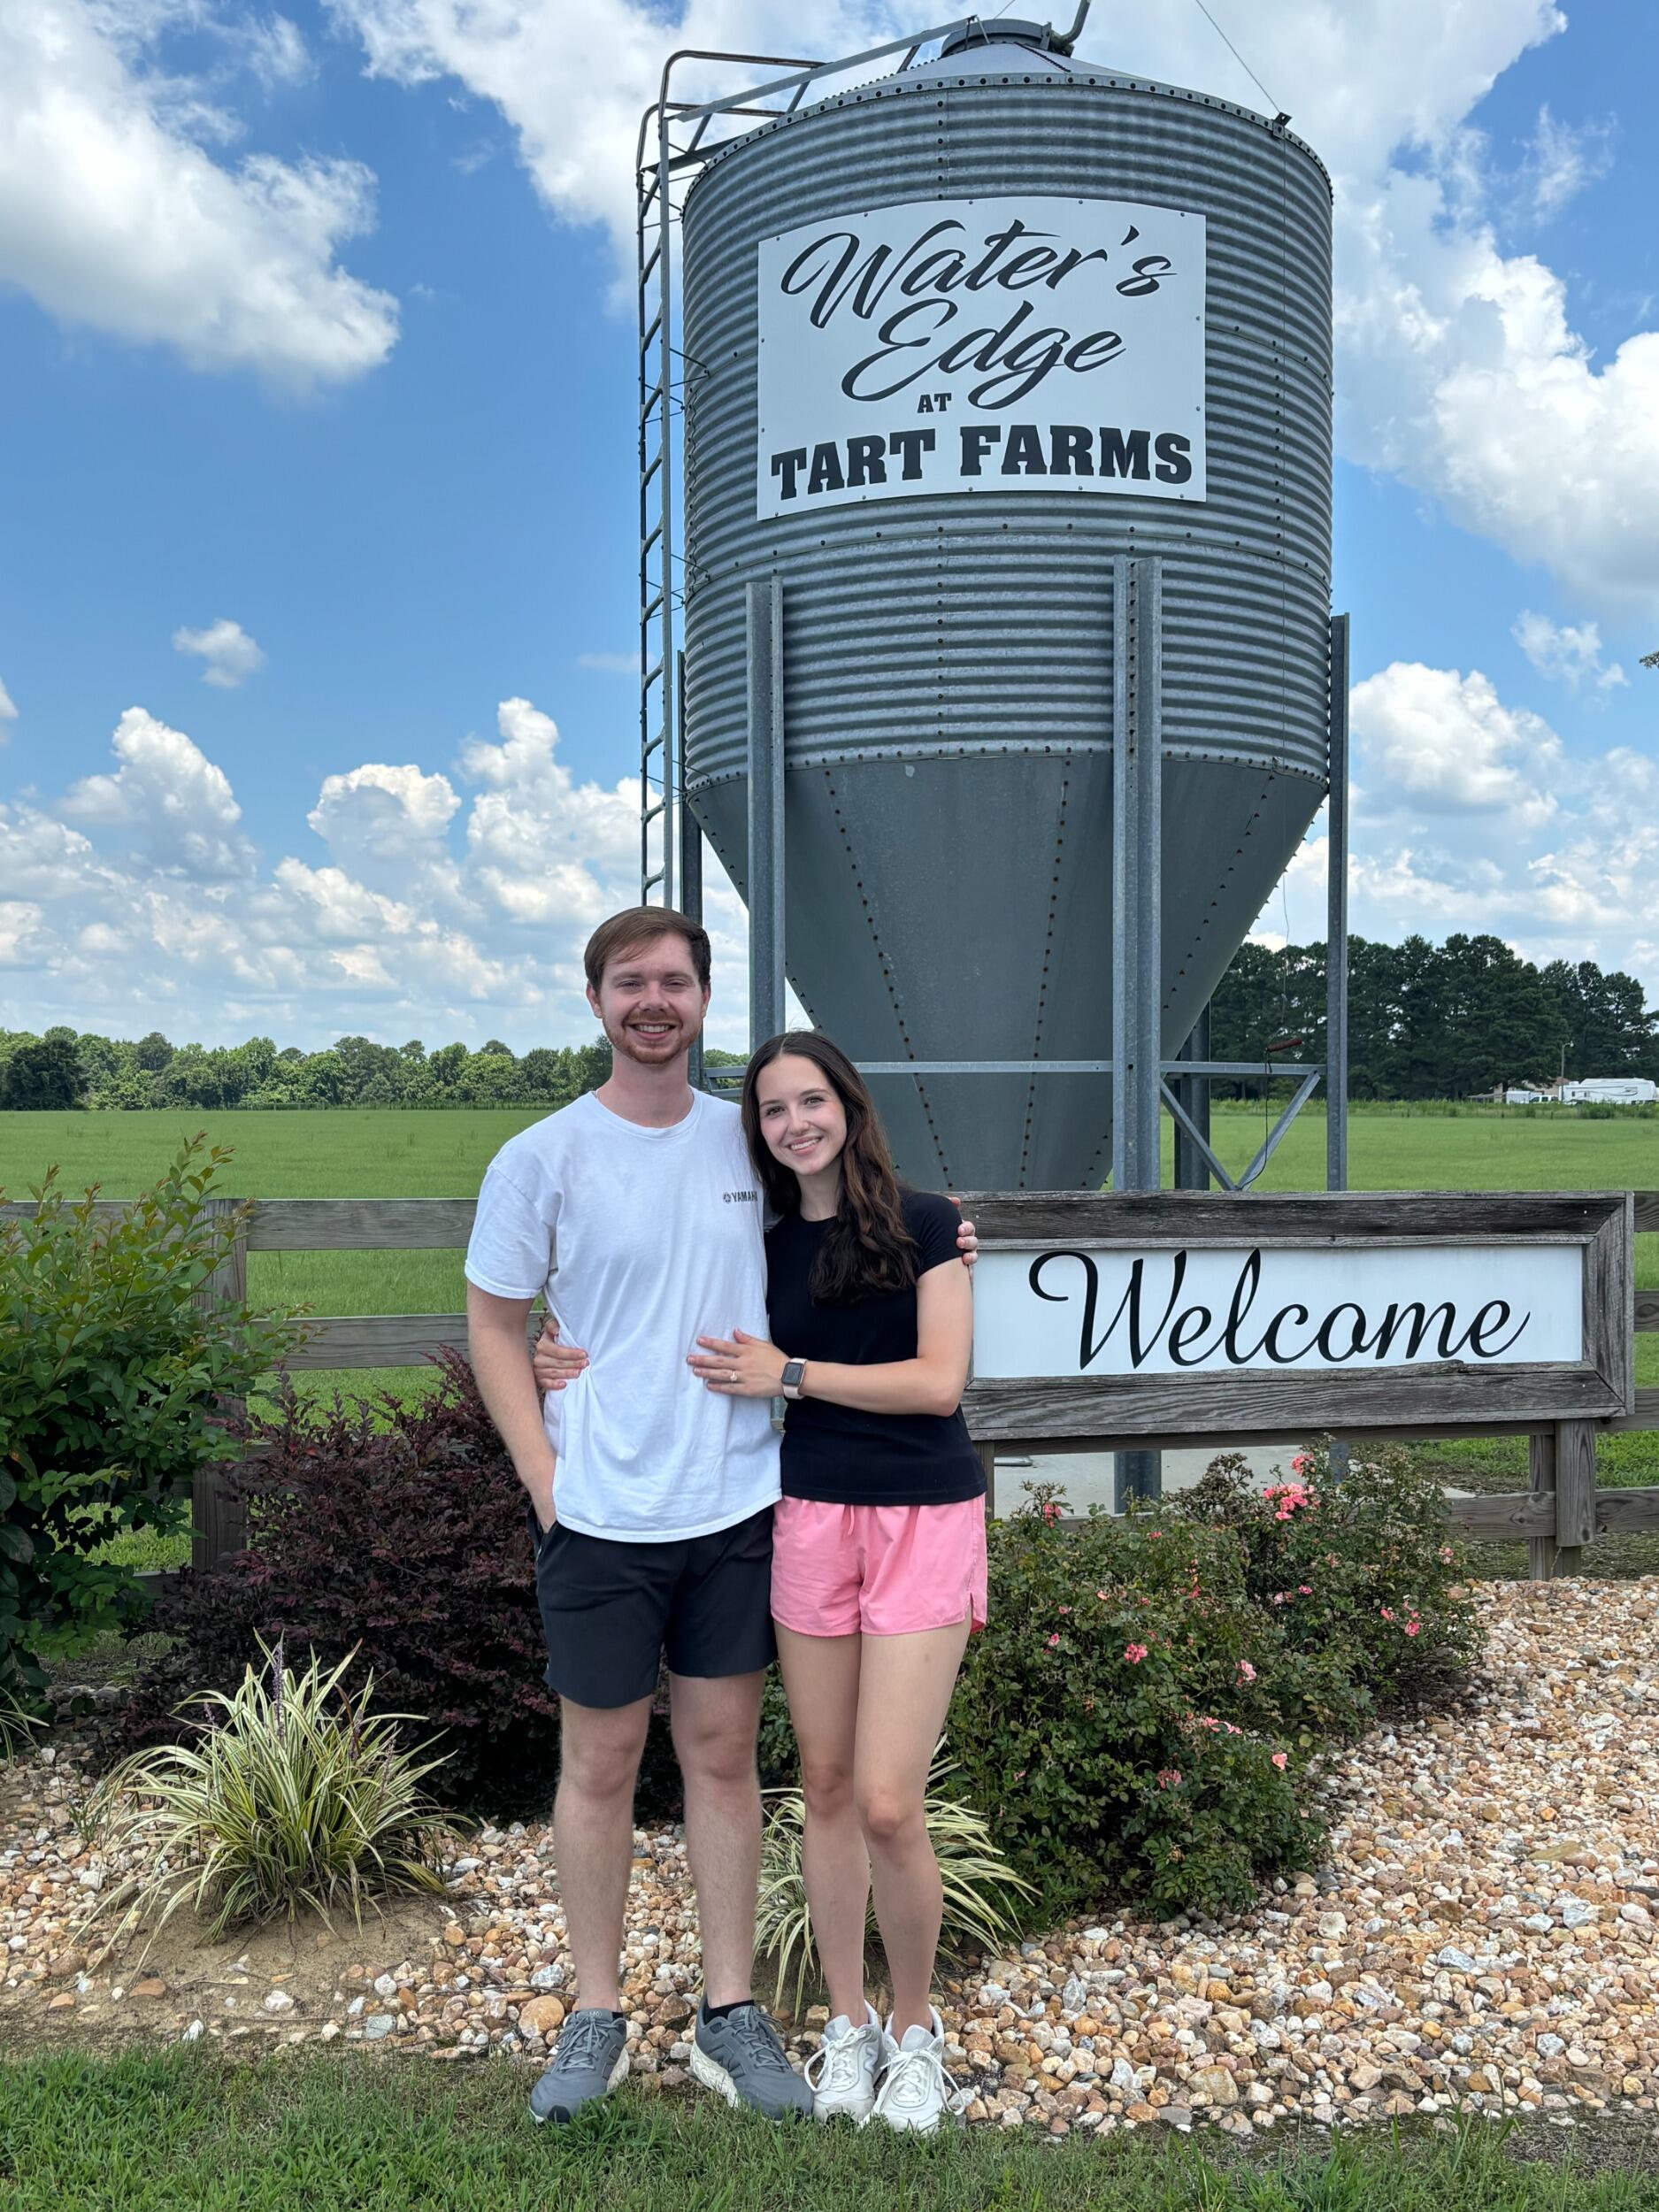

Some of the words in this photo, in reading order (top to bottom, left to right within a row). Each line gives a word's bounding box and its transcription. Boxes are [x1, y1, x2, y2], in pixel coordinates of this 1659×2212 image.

[780, 219, 1179, 329] Water's
[841, 297, 1127, 411] Edge
[917, 392, 952, 414] AT
[771, 428, 936, 501] TART
[959, 425, 1192, 485] FARMS
[1028, 1248, 1531, 1371] Welcome
